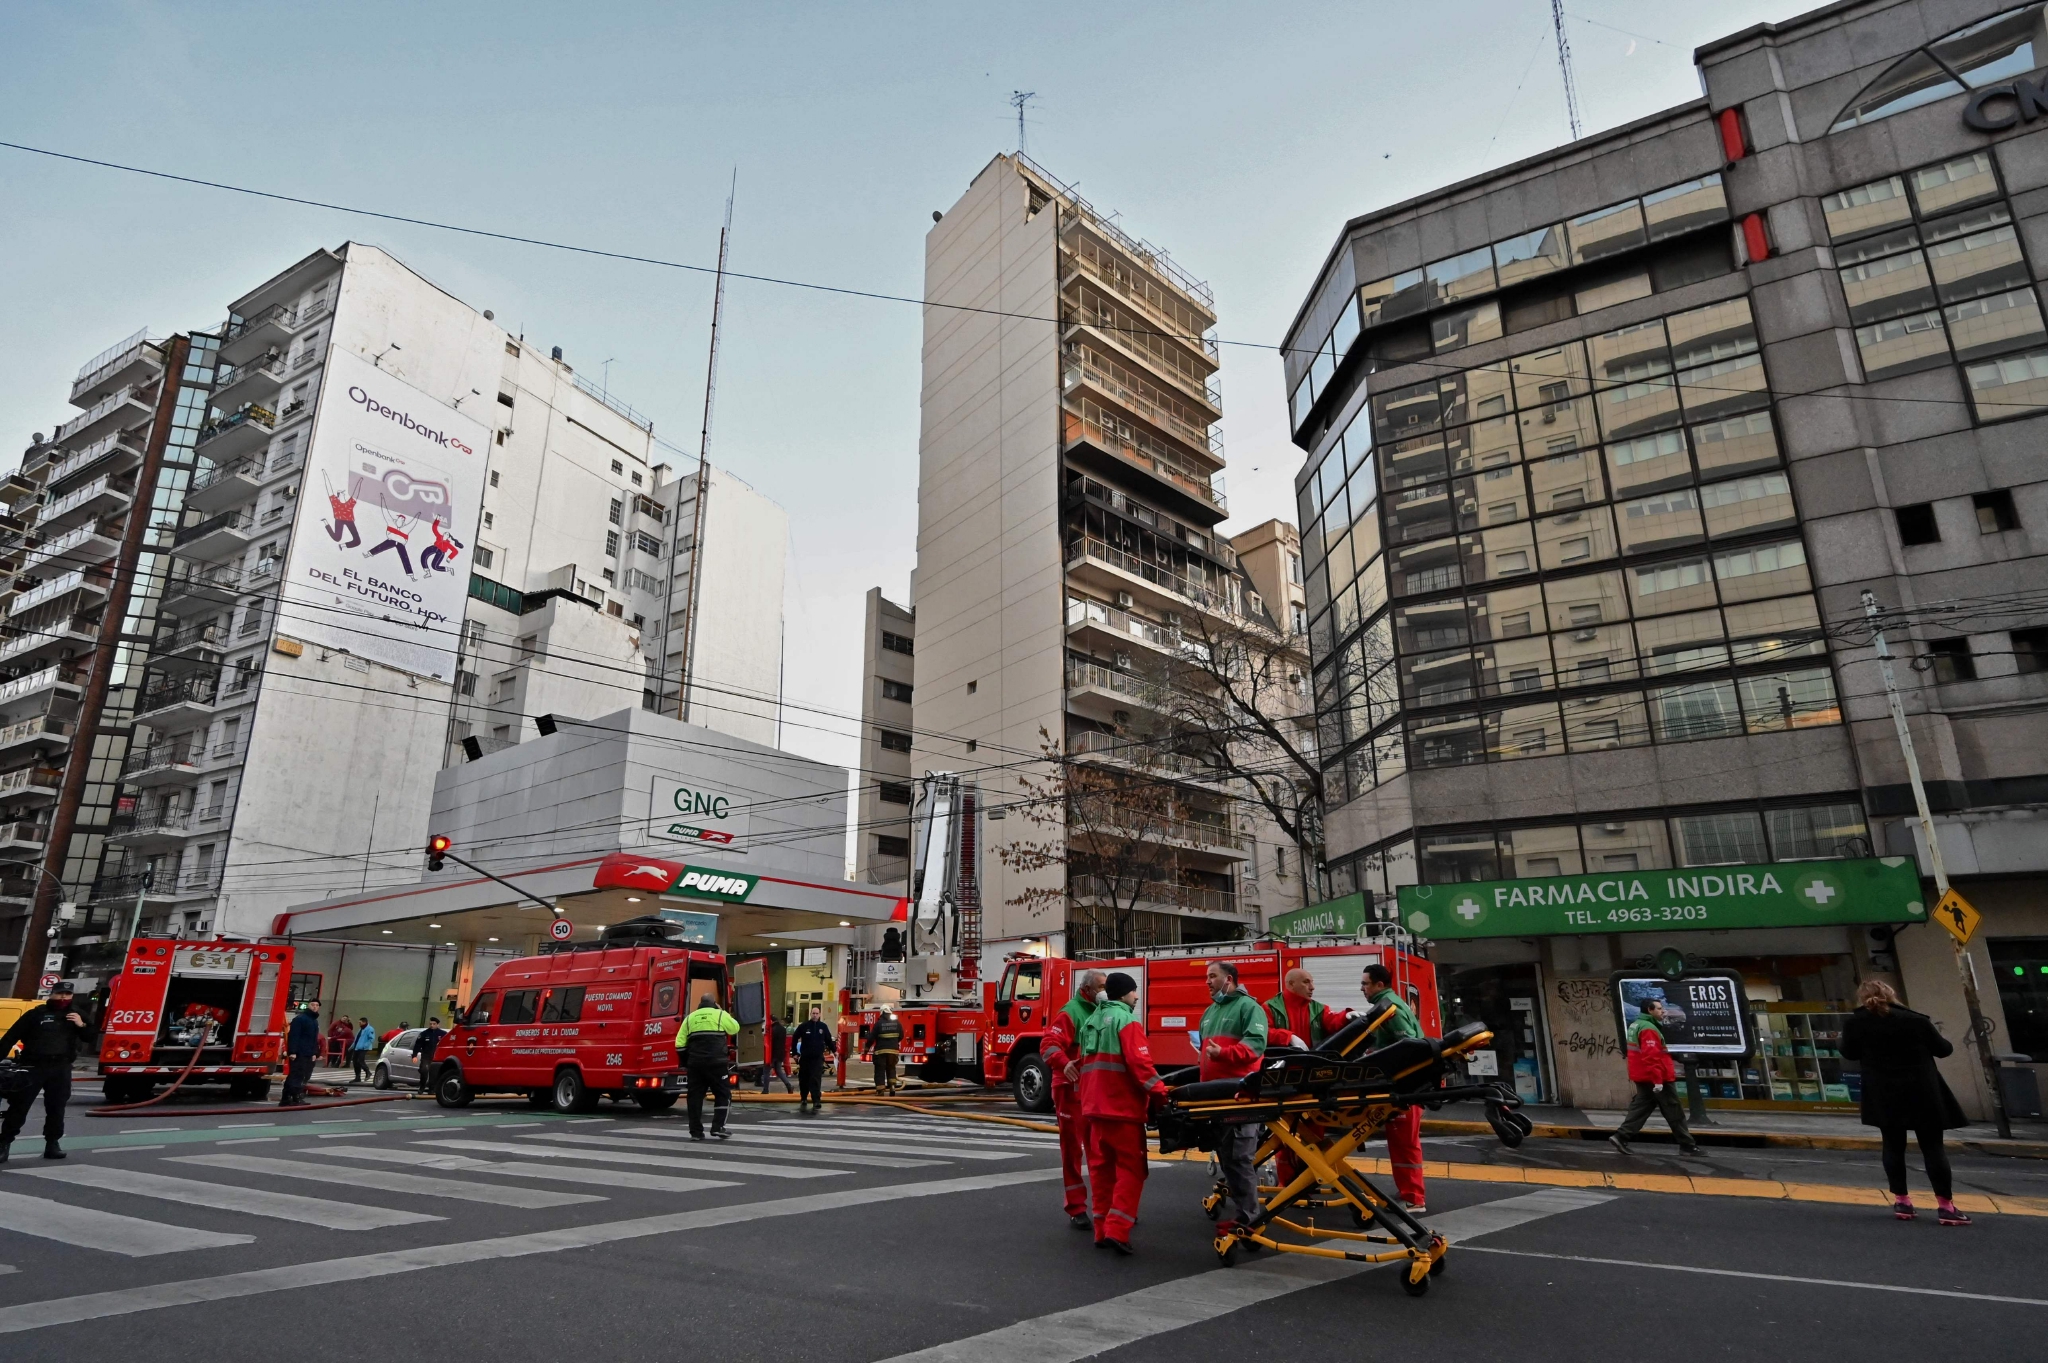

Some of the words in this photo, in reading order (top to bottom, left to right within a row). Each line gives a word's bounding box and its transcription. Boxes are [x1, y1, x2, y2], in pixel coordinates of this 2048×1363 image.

[348, 386, 449, 449] Openbank
[355, 443, 396, 463] Openbank
[432, 512, 448, 524] VSA
[342, 567, 362, 582] EL
[368, 577, 423, 603] BANCO
[309, 567, 342, 587] DEL
[347, 582, 412, 613] FUTURO,
[417, 607, 447, 623] HOY
[674, 788, 729, 819] GNC
[672, 826, 699, 837] PUMA
[679, 872, 748, 896] PUMA
[1494, 880, 1649, 908] FARMACIA
[1667, 873, 1783, 899] INDIRA
[1564, 911, 1601, 925] TEL.
[1607, 905, 1707, 923] 4963-3203
[555, 925, 568, 934] 50
[1293, 911, 1335, 935] FARMACIA
[190, 952, 236, 970] 631
[1059, 977, 1065, 986] 4
[585, 993, 605, 1001] PUESTO
[605, 992, 633, 1000] COMANDO
[1689, 985, 1727, 1001] EROS
[1692, 1001, 1729, 1009] RAMAZZOTTI
[112, 1010, 155, 1023] 2673
[864, 1013, 877, 1024] 9051
[551, 1028, 558, 1036] LA
[560, 1028, 579, 1036] CIUDAD
[644, 1022, 662, 1035] 2646
[997, 1033, 1015, 1044] 2669
[606, 1053, 622, 1066] 2646
[1315, 1069, 1334, 1078] XPS
[1352, 1106, 1386, 1142] stryker
